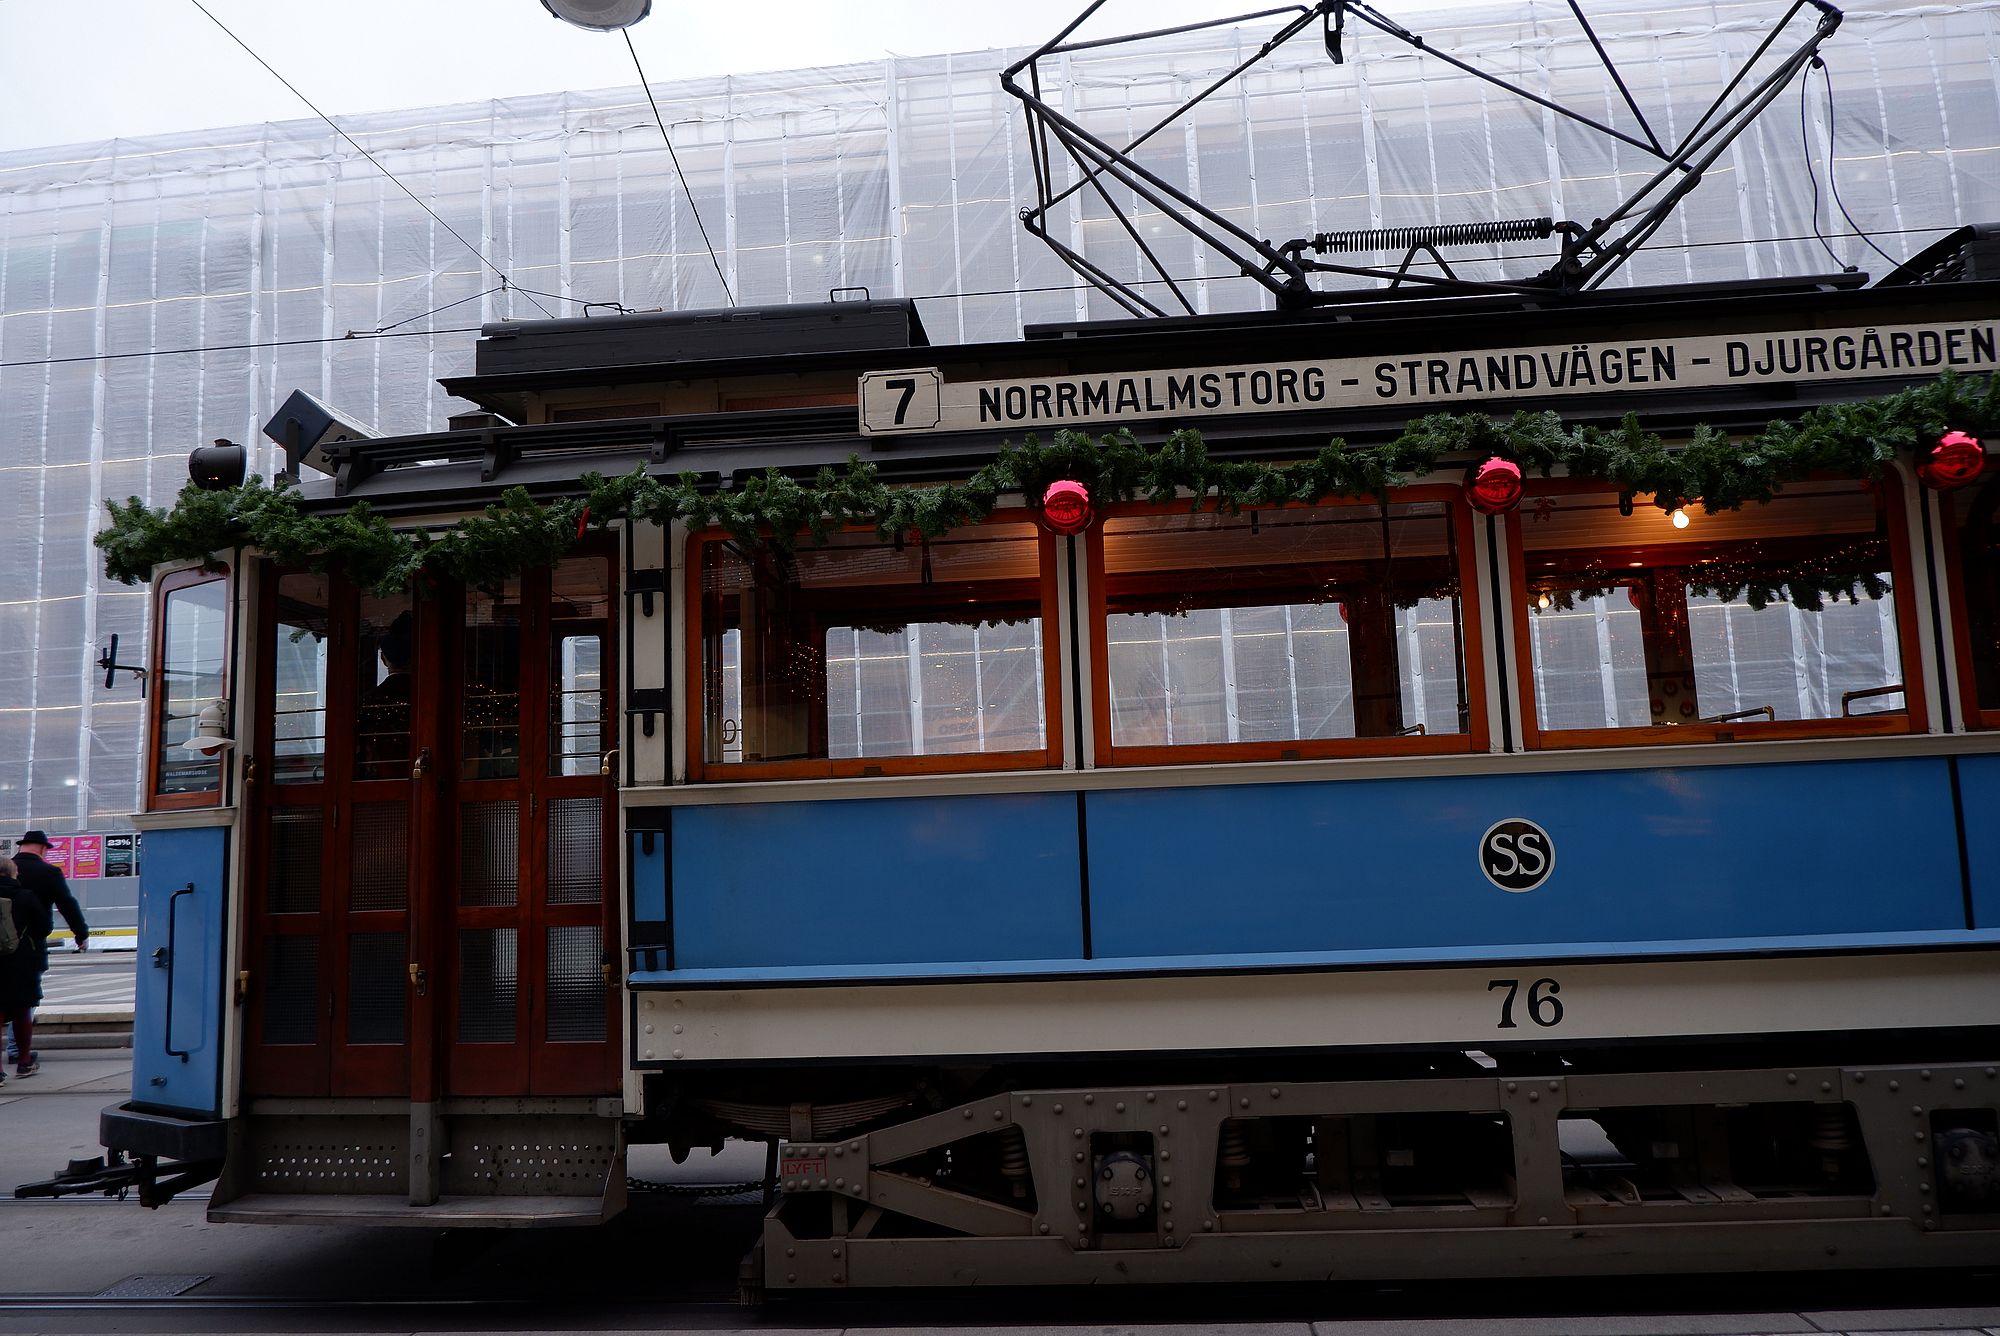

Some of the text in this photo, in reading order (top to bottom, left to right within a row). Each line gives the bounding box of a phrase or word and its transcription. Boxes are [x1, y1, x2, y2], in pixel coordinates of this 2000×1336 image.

[979, 368, 1325, 422] NORRMALMSTORG
[1375, 345, 1677, 398] STRANDVÄGEN
[1726, 326, 1997, 377] DJURGÅRDEN
[886, 379, 916, 425] 7
[1490, 832, 1546, 877] SS
[1488, 978, 1564, 1028] 76
[786, 1162, 823, 1175] LYFT
